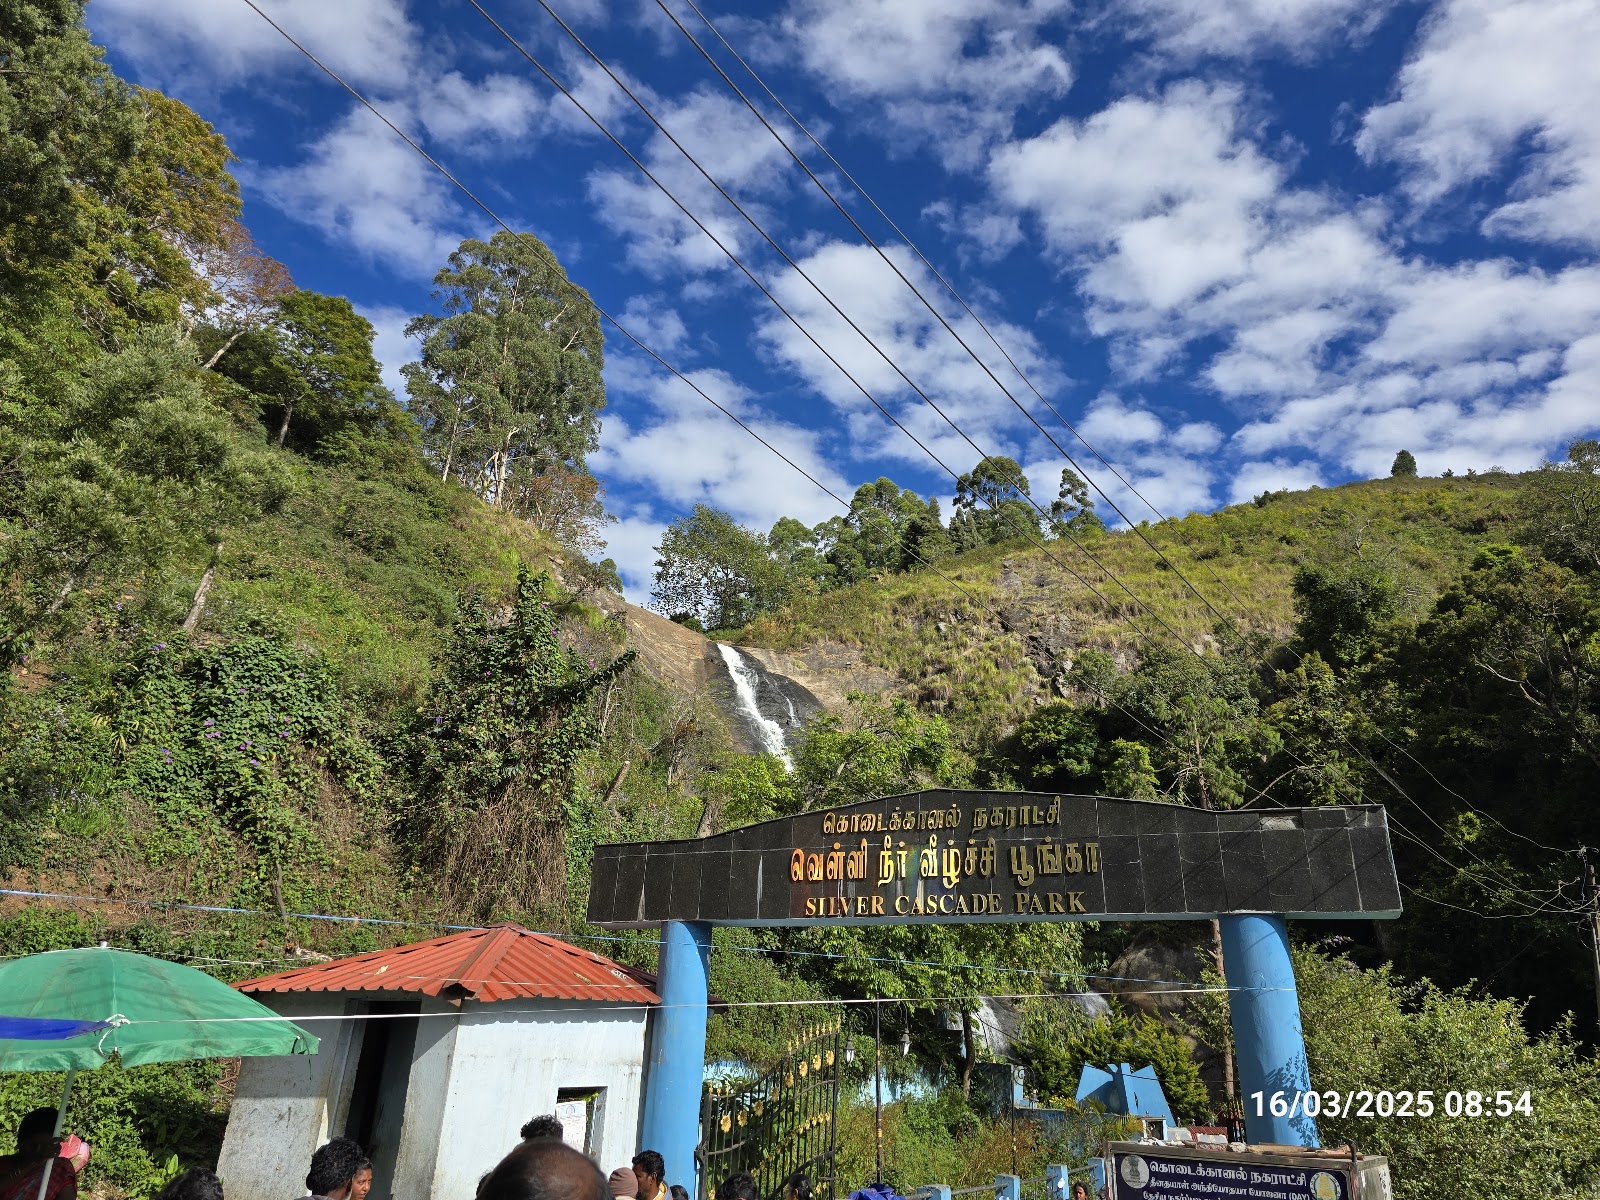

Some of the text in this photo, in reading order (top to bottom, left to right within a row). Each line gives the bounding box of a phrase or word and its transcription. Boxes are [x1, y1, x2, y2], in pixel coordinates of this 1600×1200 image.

[822, 796, 1061, 834] கொடைக்கானல் நகராட்சி
[790, 834, 1099, 889] வெள்ளி நீர் வீழ்ச்சி பூங்கா
[805, 891, 1088, 916] SILVER CASCADE PARK
[1149, 1161, 1307, 1187] கொடைக்கானல் நகராட்சி
[1288, 1191, 1310, 1200] (DAY)
